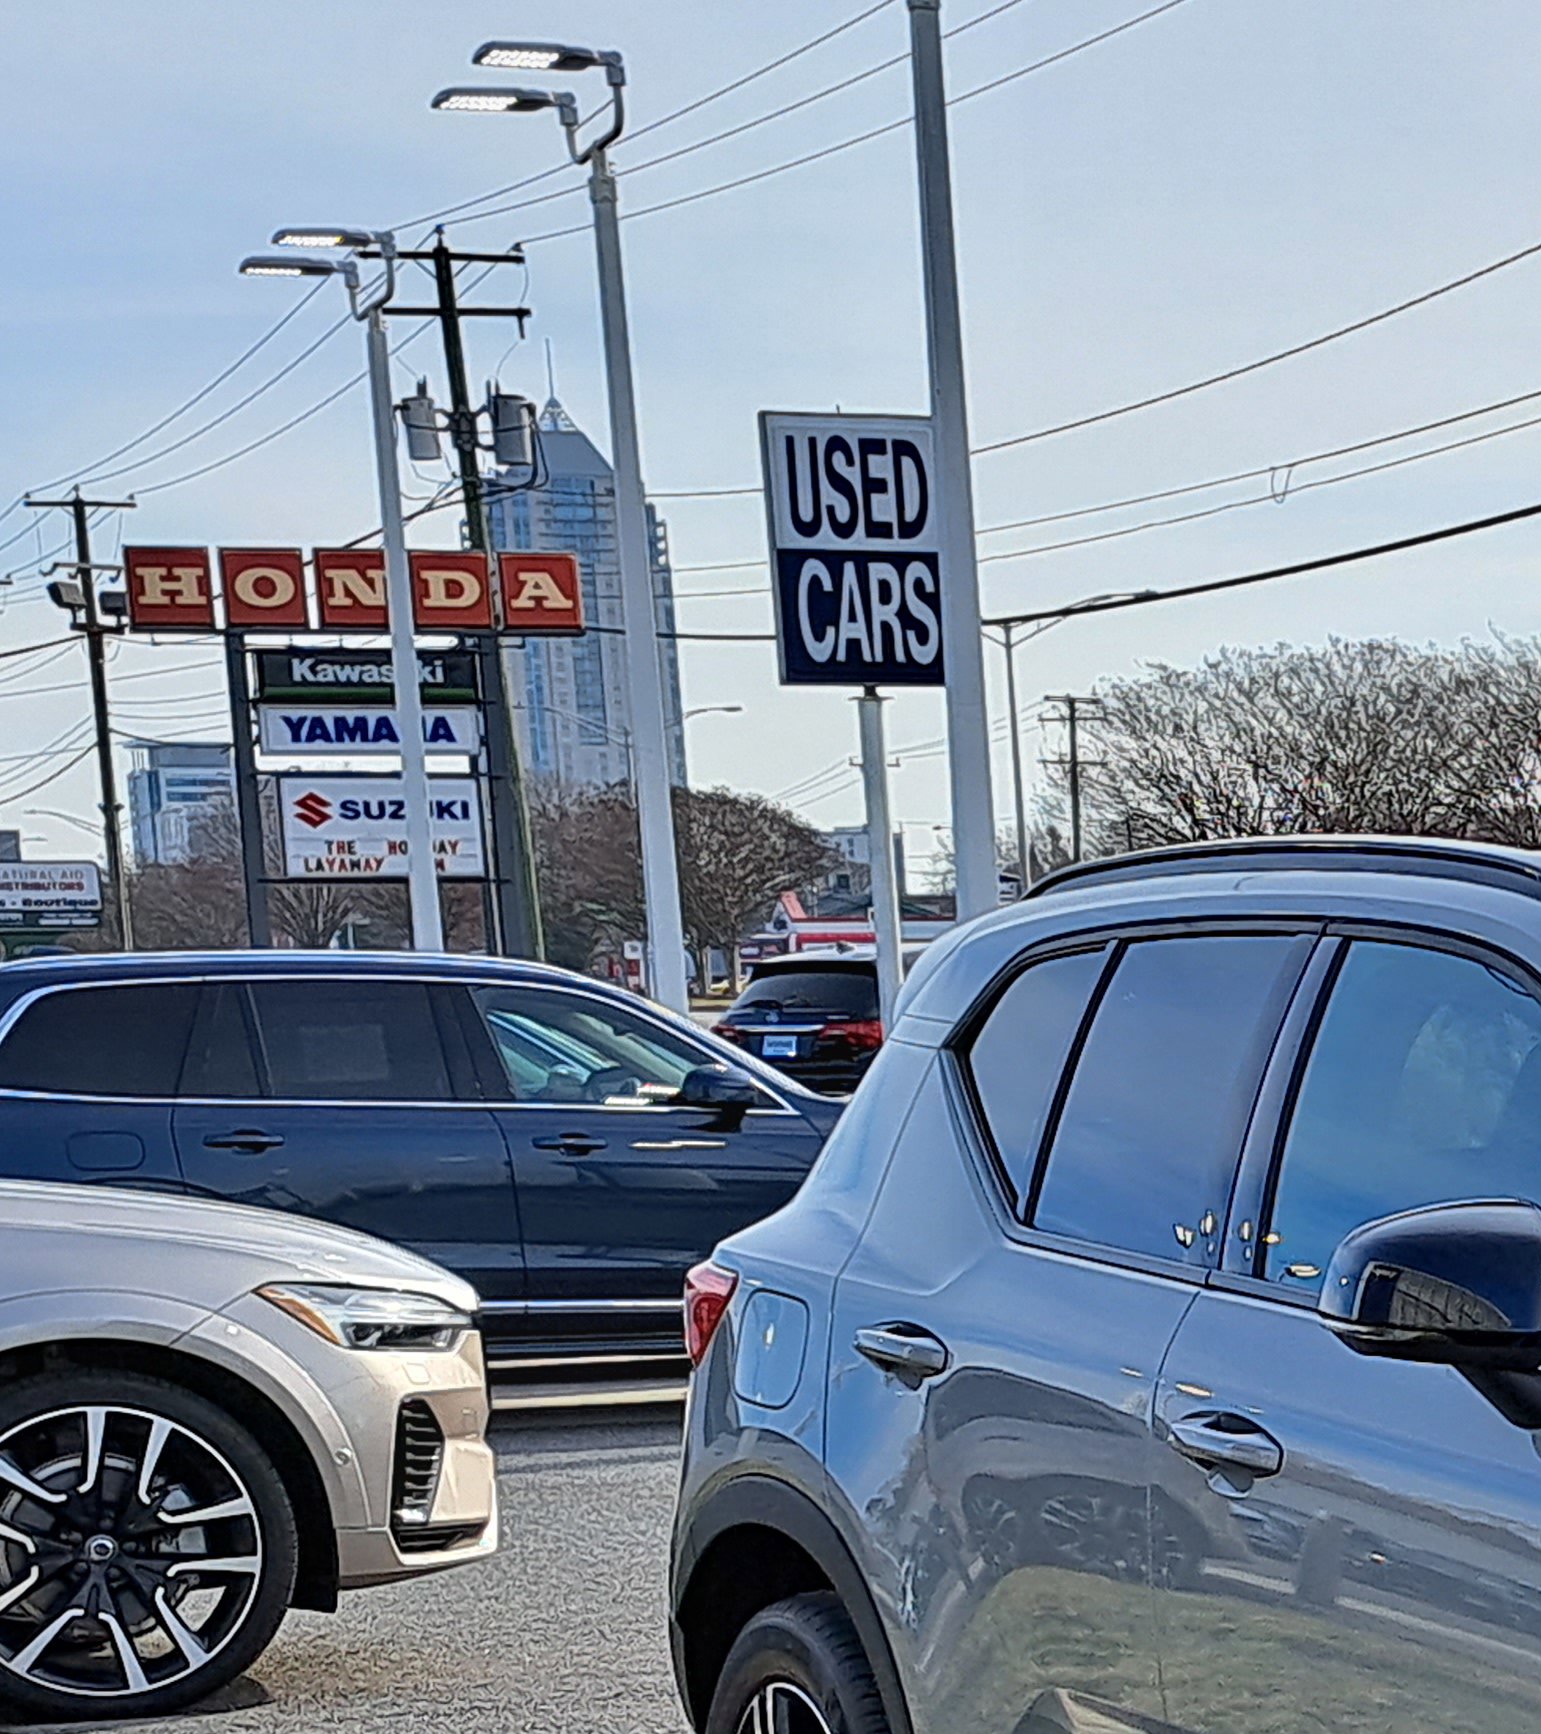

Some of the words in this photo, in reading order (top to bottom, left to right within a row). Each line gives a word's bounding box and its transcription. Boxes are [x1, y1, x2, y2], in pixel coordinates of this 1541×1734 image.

[785, 434, 929, 540] USED
[135, 566, 573, 608] HONDA
[798, 557, 940, 666] CARS
[291, 657, 445, 683] Kawaski
[280, 715, 457, 743] YAMAA
[338, 799, 471, 820] SUZKI
[324, 840, 357, 855] THE
[387, 839, 460, 855] HOAY
